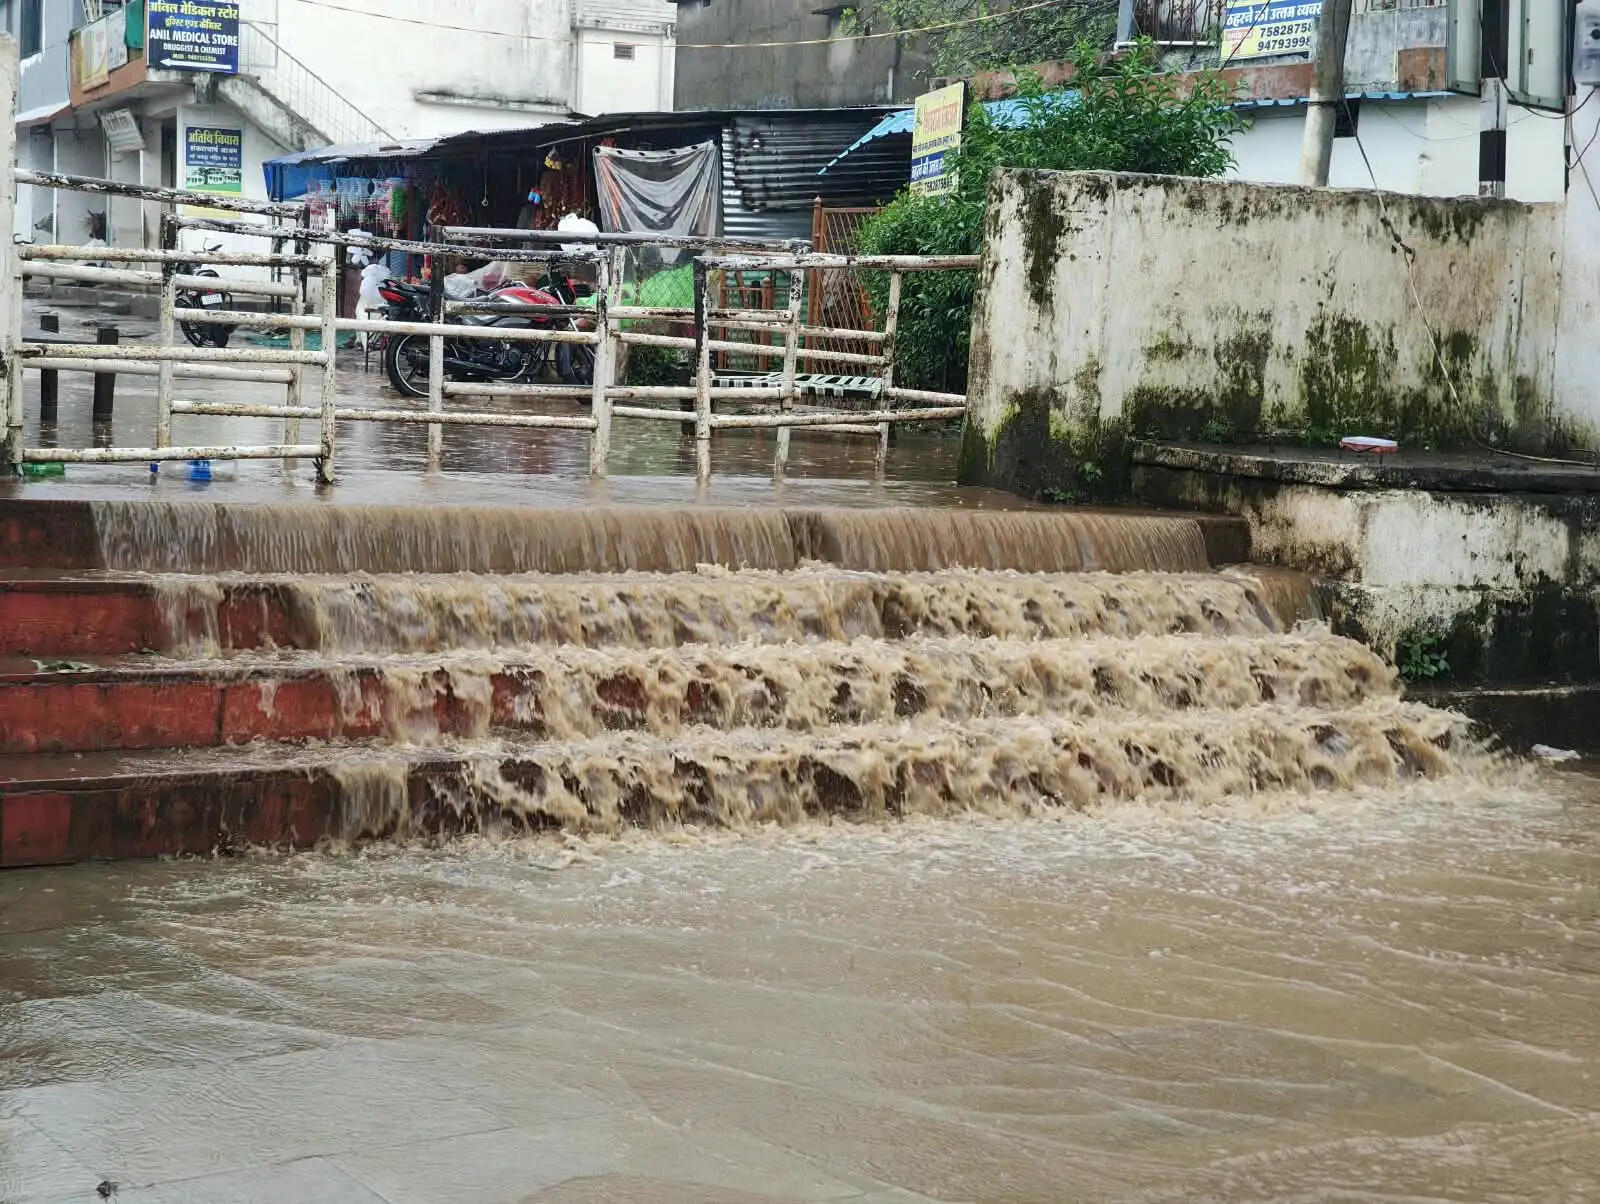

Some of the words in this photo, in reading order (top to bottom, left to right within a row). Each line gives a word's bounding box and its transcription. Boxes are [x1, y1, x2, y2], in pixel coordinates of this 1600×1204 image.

[149, 0, 177, 13] अनिल
[181, 1, 216, 17] मेडिकल
[217, 5, 238, 19] स्टोर
[1226, 7, 1254, 26] ठहरने
[1254, 7, 1270, 21] की
[1270, 6, 1296, 20] उत्तम
[150, 29, 171, 40] ANIL
[172, 31, 210, 44] MEDICAL
[212, 34, 238, 46] STORE
[163, 43, 193, 53] DRUGGIST
[200, 46, 226, 55] CHEMIST
[188, 129, 213, 143] अतिथि
